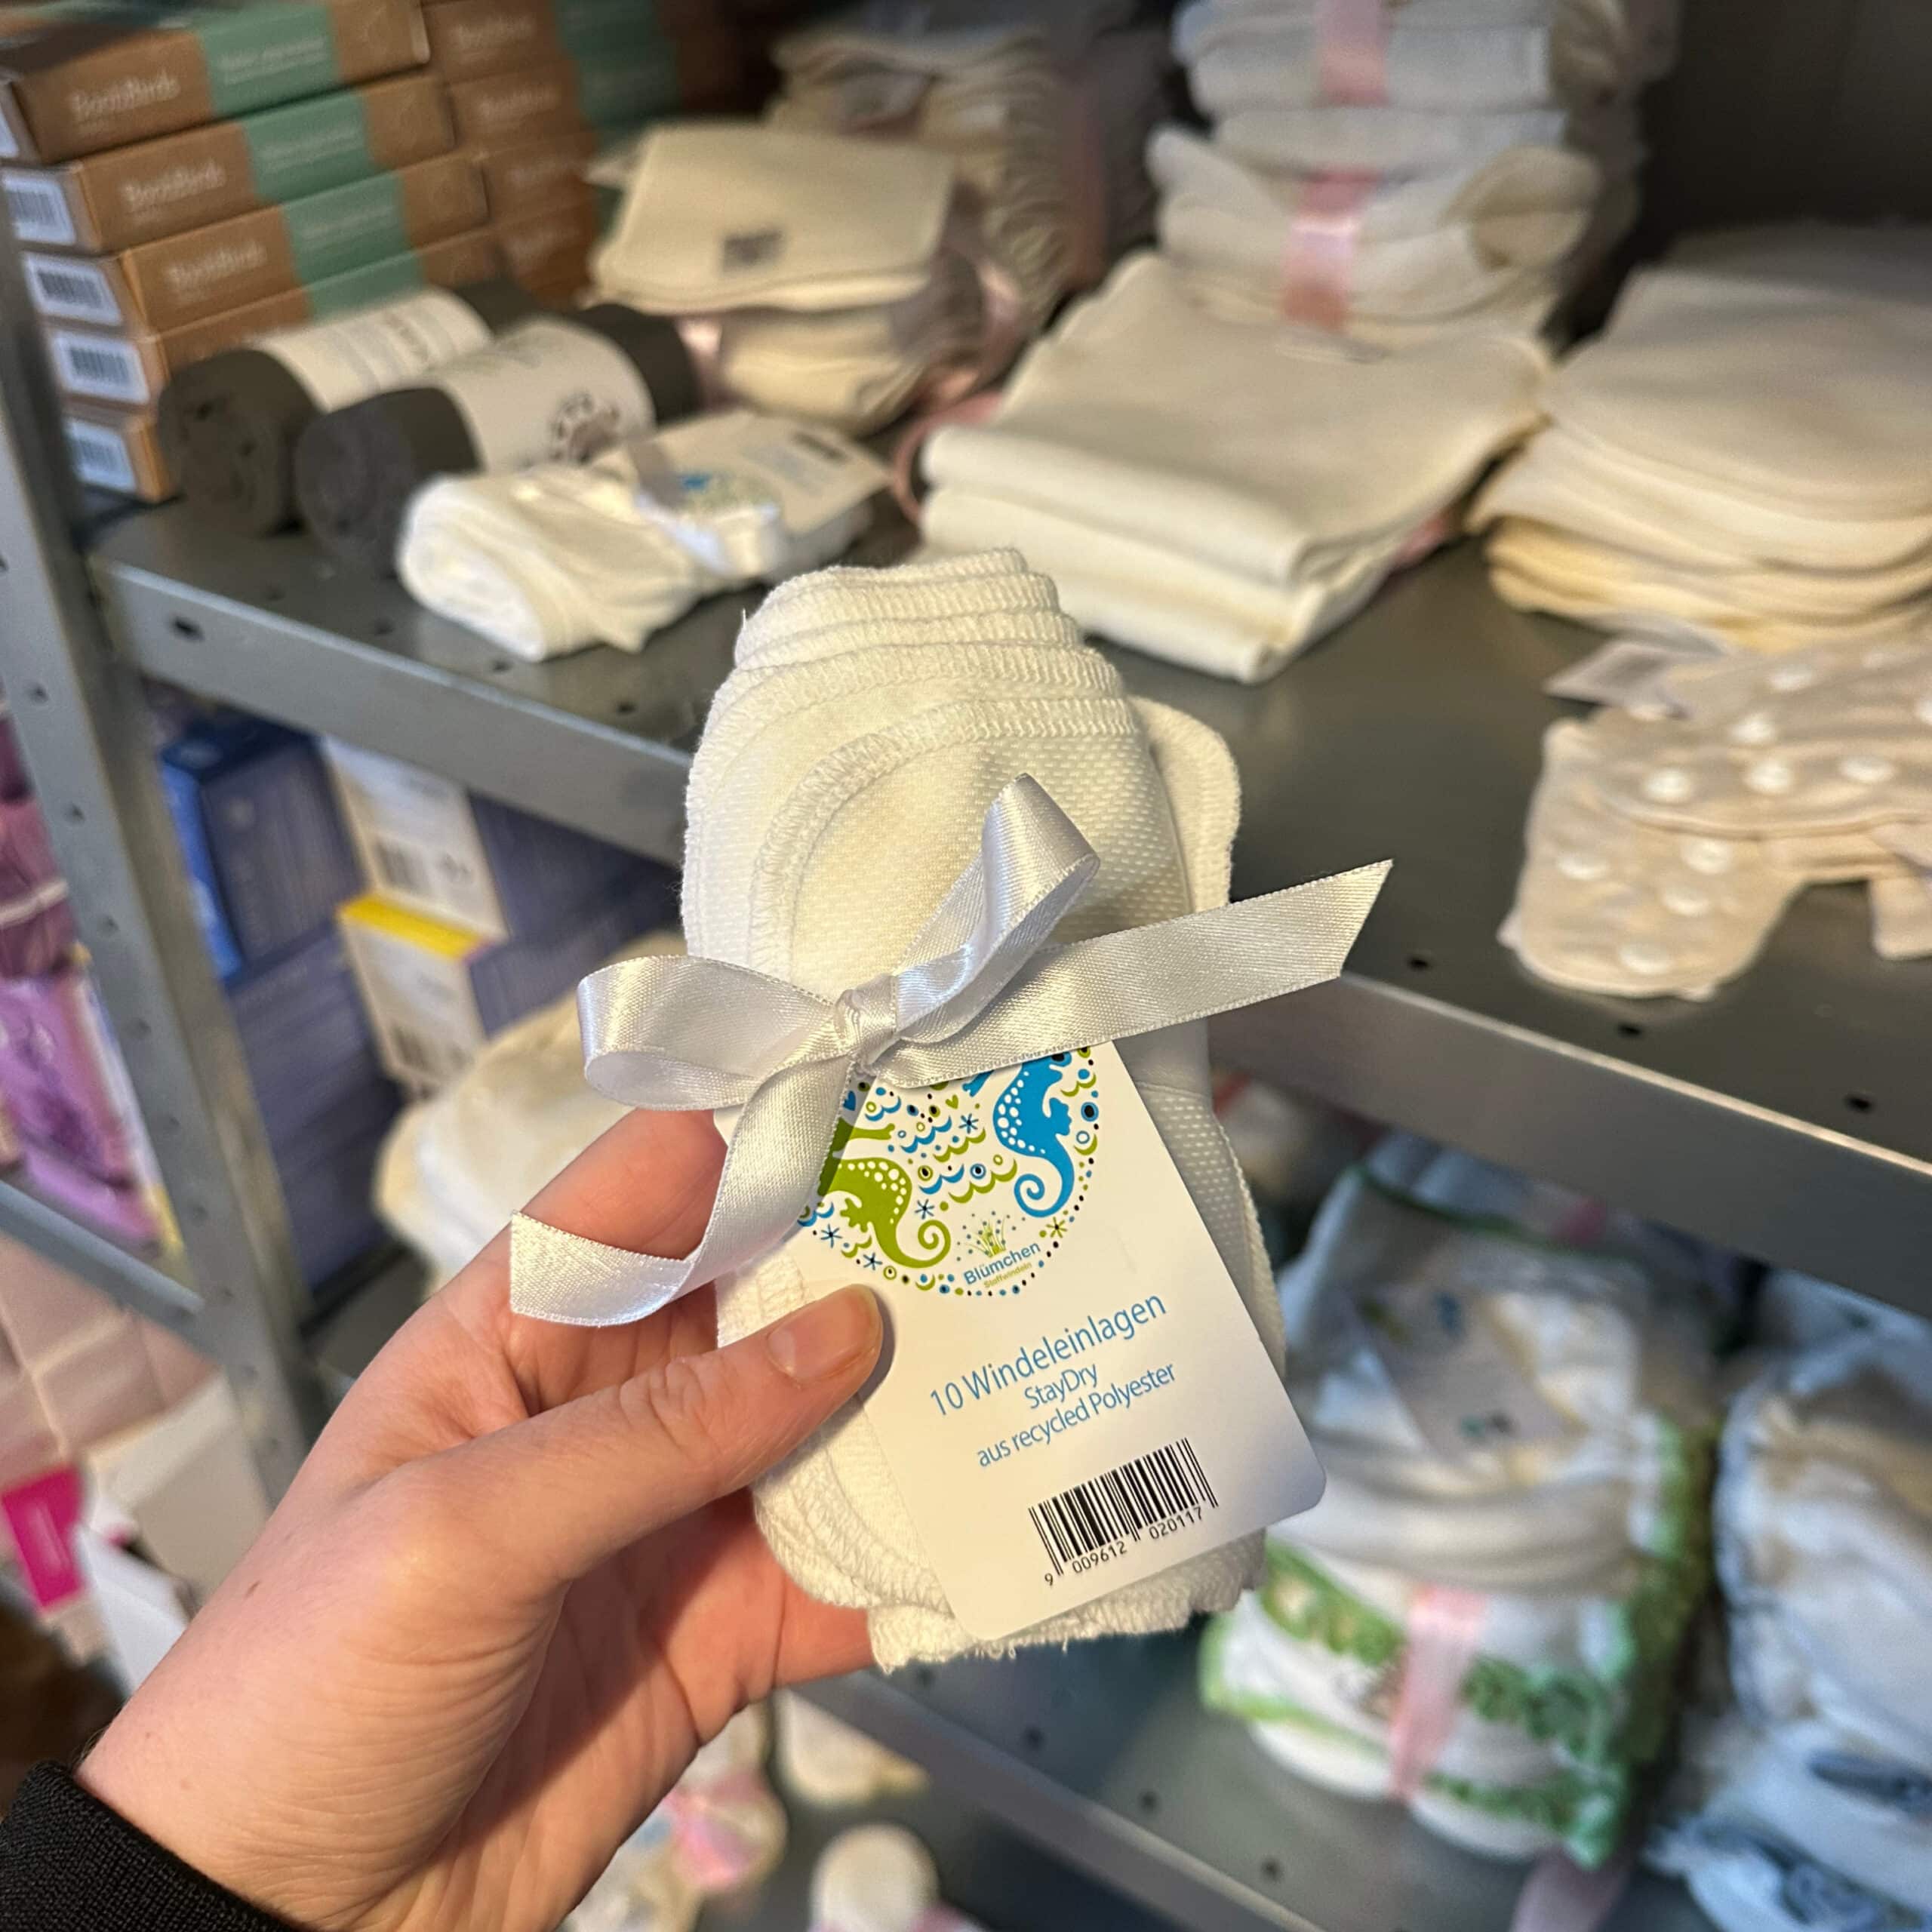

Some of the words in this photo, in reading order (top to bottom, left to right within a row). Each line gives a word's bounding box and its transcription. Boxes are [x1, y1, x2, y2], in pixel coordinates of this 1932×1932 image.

[963, 1242, 1041, 1285] Blümchen
[983, 1261, 1032, 1288] Stoffwindeln
[931, 1382, 964, 1416] 10
[961, 1295, 1167, 1400] Windeleinlagen
[1024, 1364, 1098, 1409] StayDry
[977, 1439, 1011, 1467] aus
[1011, 1398, 1091, 1451] recycled
[1088, 1363, 1176, 1414] Polyester
[1044, 1572, 1054, 1586] 9
[1072, 1540, 1128, 1574] 009612
[1148, 1506, 1203, 1540] 020117
